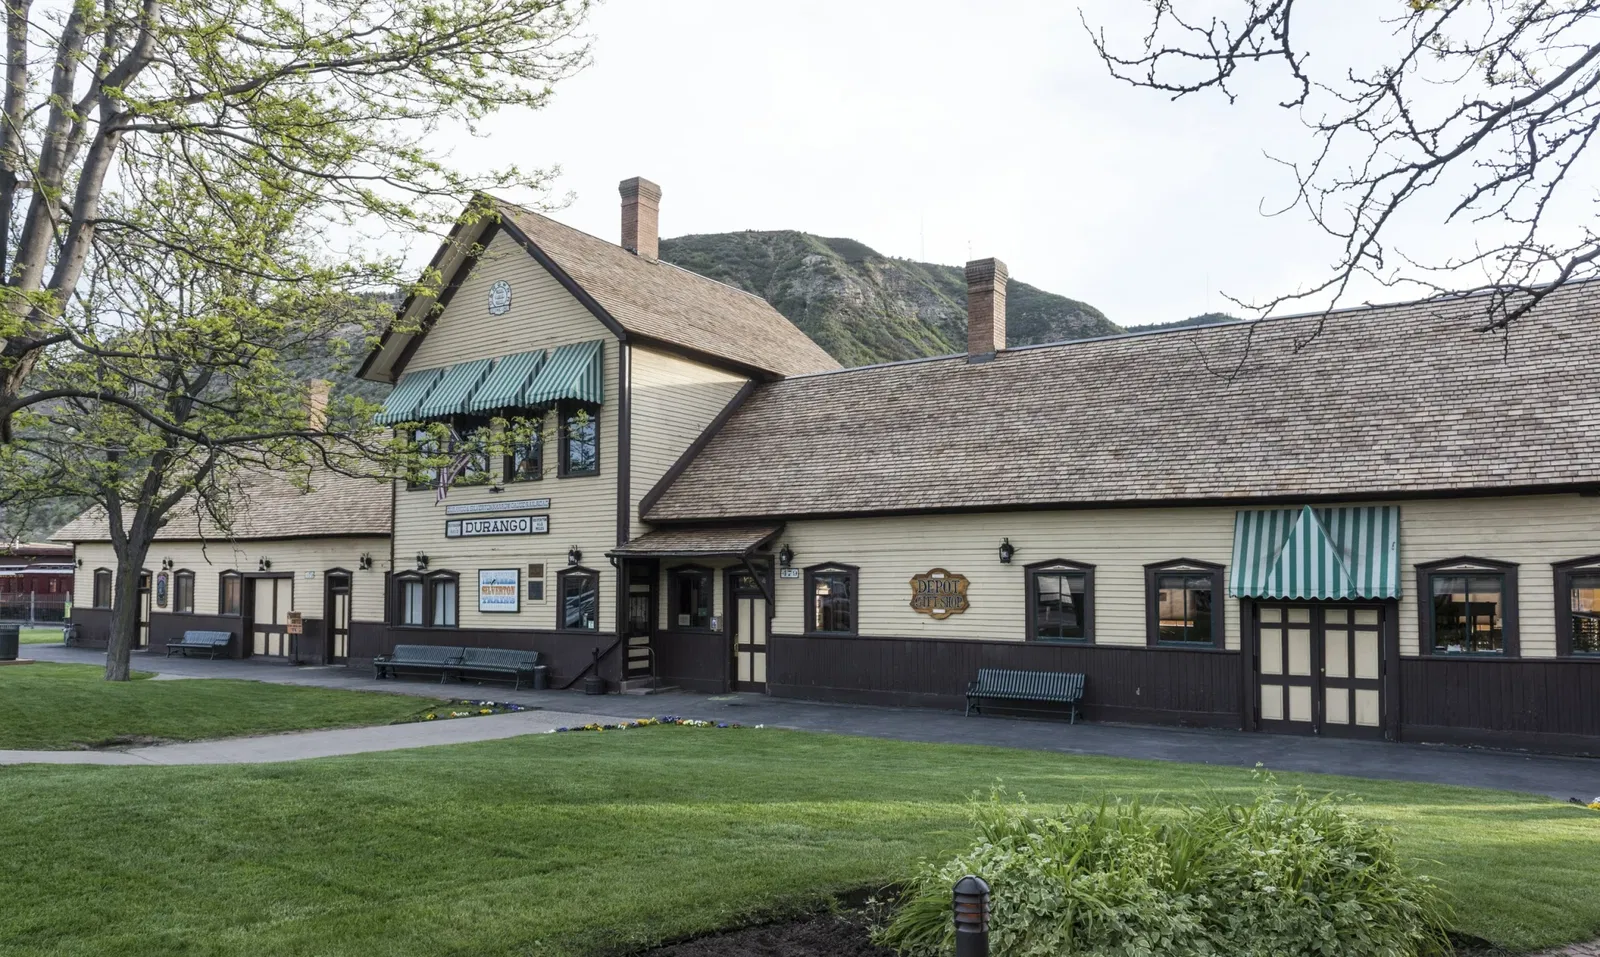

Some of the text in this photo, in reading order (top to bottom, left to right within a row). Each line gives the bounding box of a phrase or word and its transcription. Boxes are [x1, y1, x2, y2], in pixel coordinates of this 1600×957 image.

[465, 519, 527, 533] DURANGO
[482, 585, 516, 596] SILVERTON
[918, 580, 960, 593] DEPOT
[915, 596, 963, 607] GIFT SHOP
